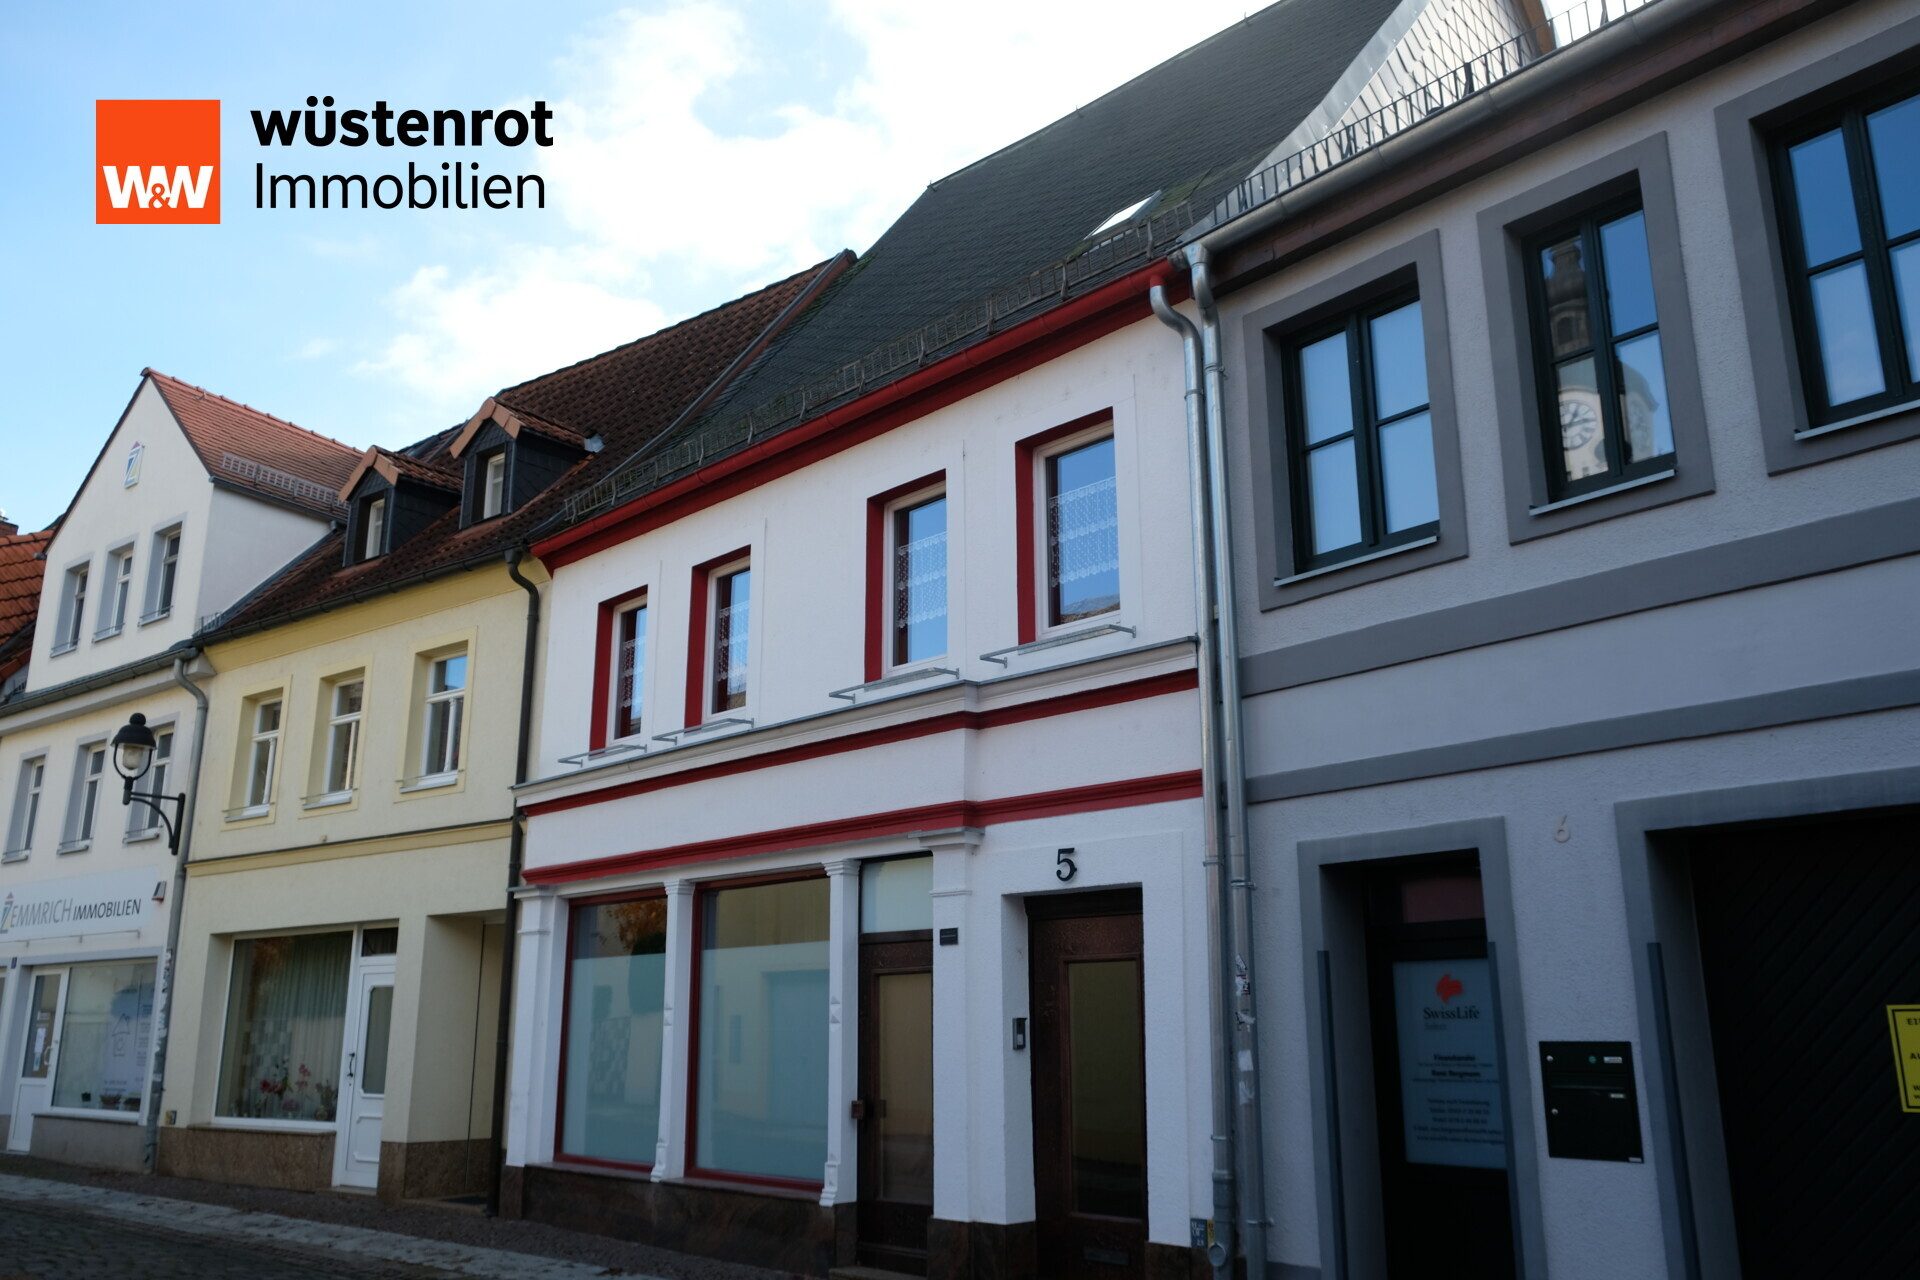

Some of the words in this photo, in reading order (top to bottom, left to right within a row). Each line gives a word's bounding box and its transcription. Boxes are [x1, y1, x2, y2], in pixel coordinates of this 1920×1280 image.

[1553, 815, 1571, 844] 6
[1056, 847, 1078, 882] 5
[72, 898, 142, 921] IMMOBILIEN
